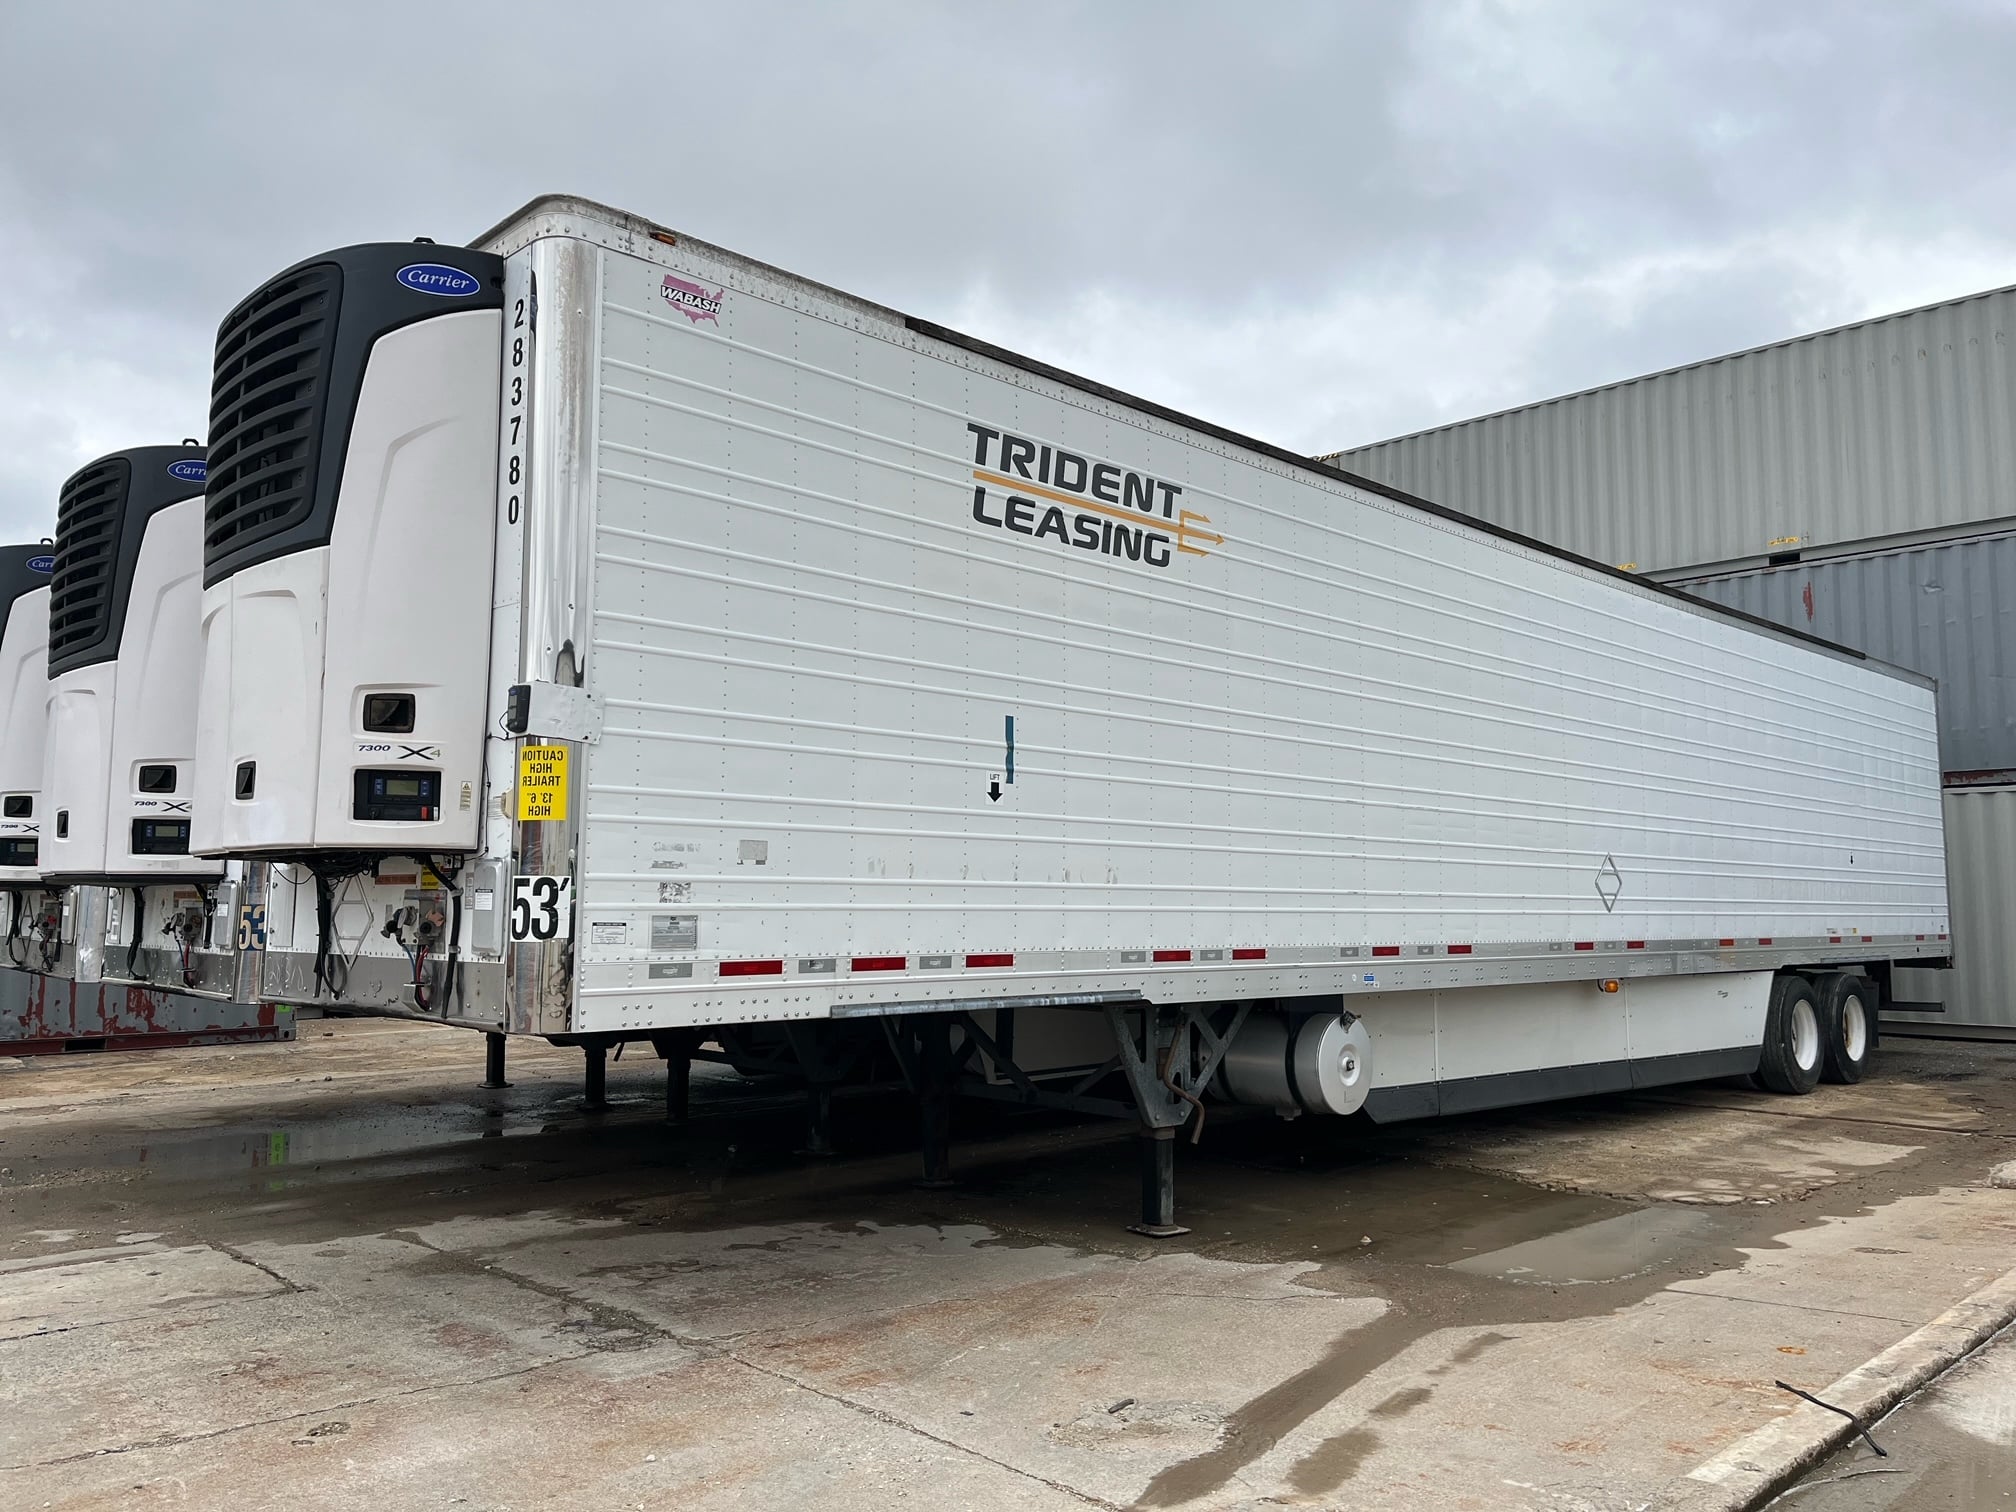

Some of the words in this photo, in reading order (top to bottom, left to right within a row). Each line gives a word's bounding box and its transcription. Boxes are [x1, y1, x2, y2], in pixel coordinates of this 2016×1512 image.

[407, 270, 470, 289] Carrier
[661, 286, 721, 314] WABASH
[507, 298, 524, 525] 283780
[967, 422, 1183, 519] TRIDENT
[972, 485, 1171, 568] LEASING
